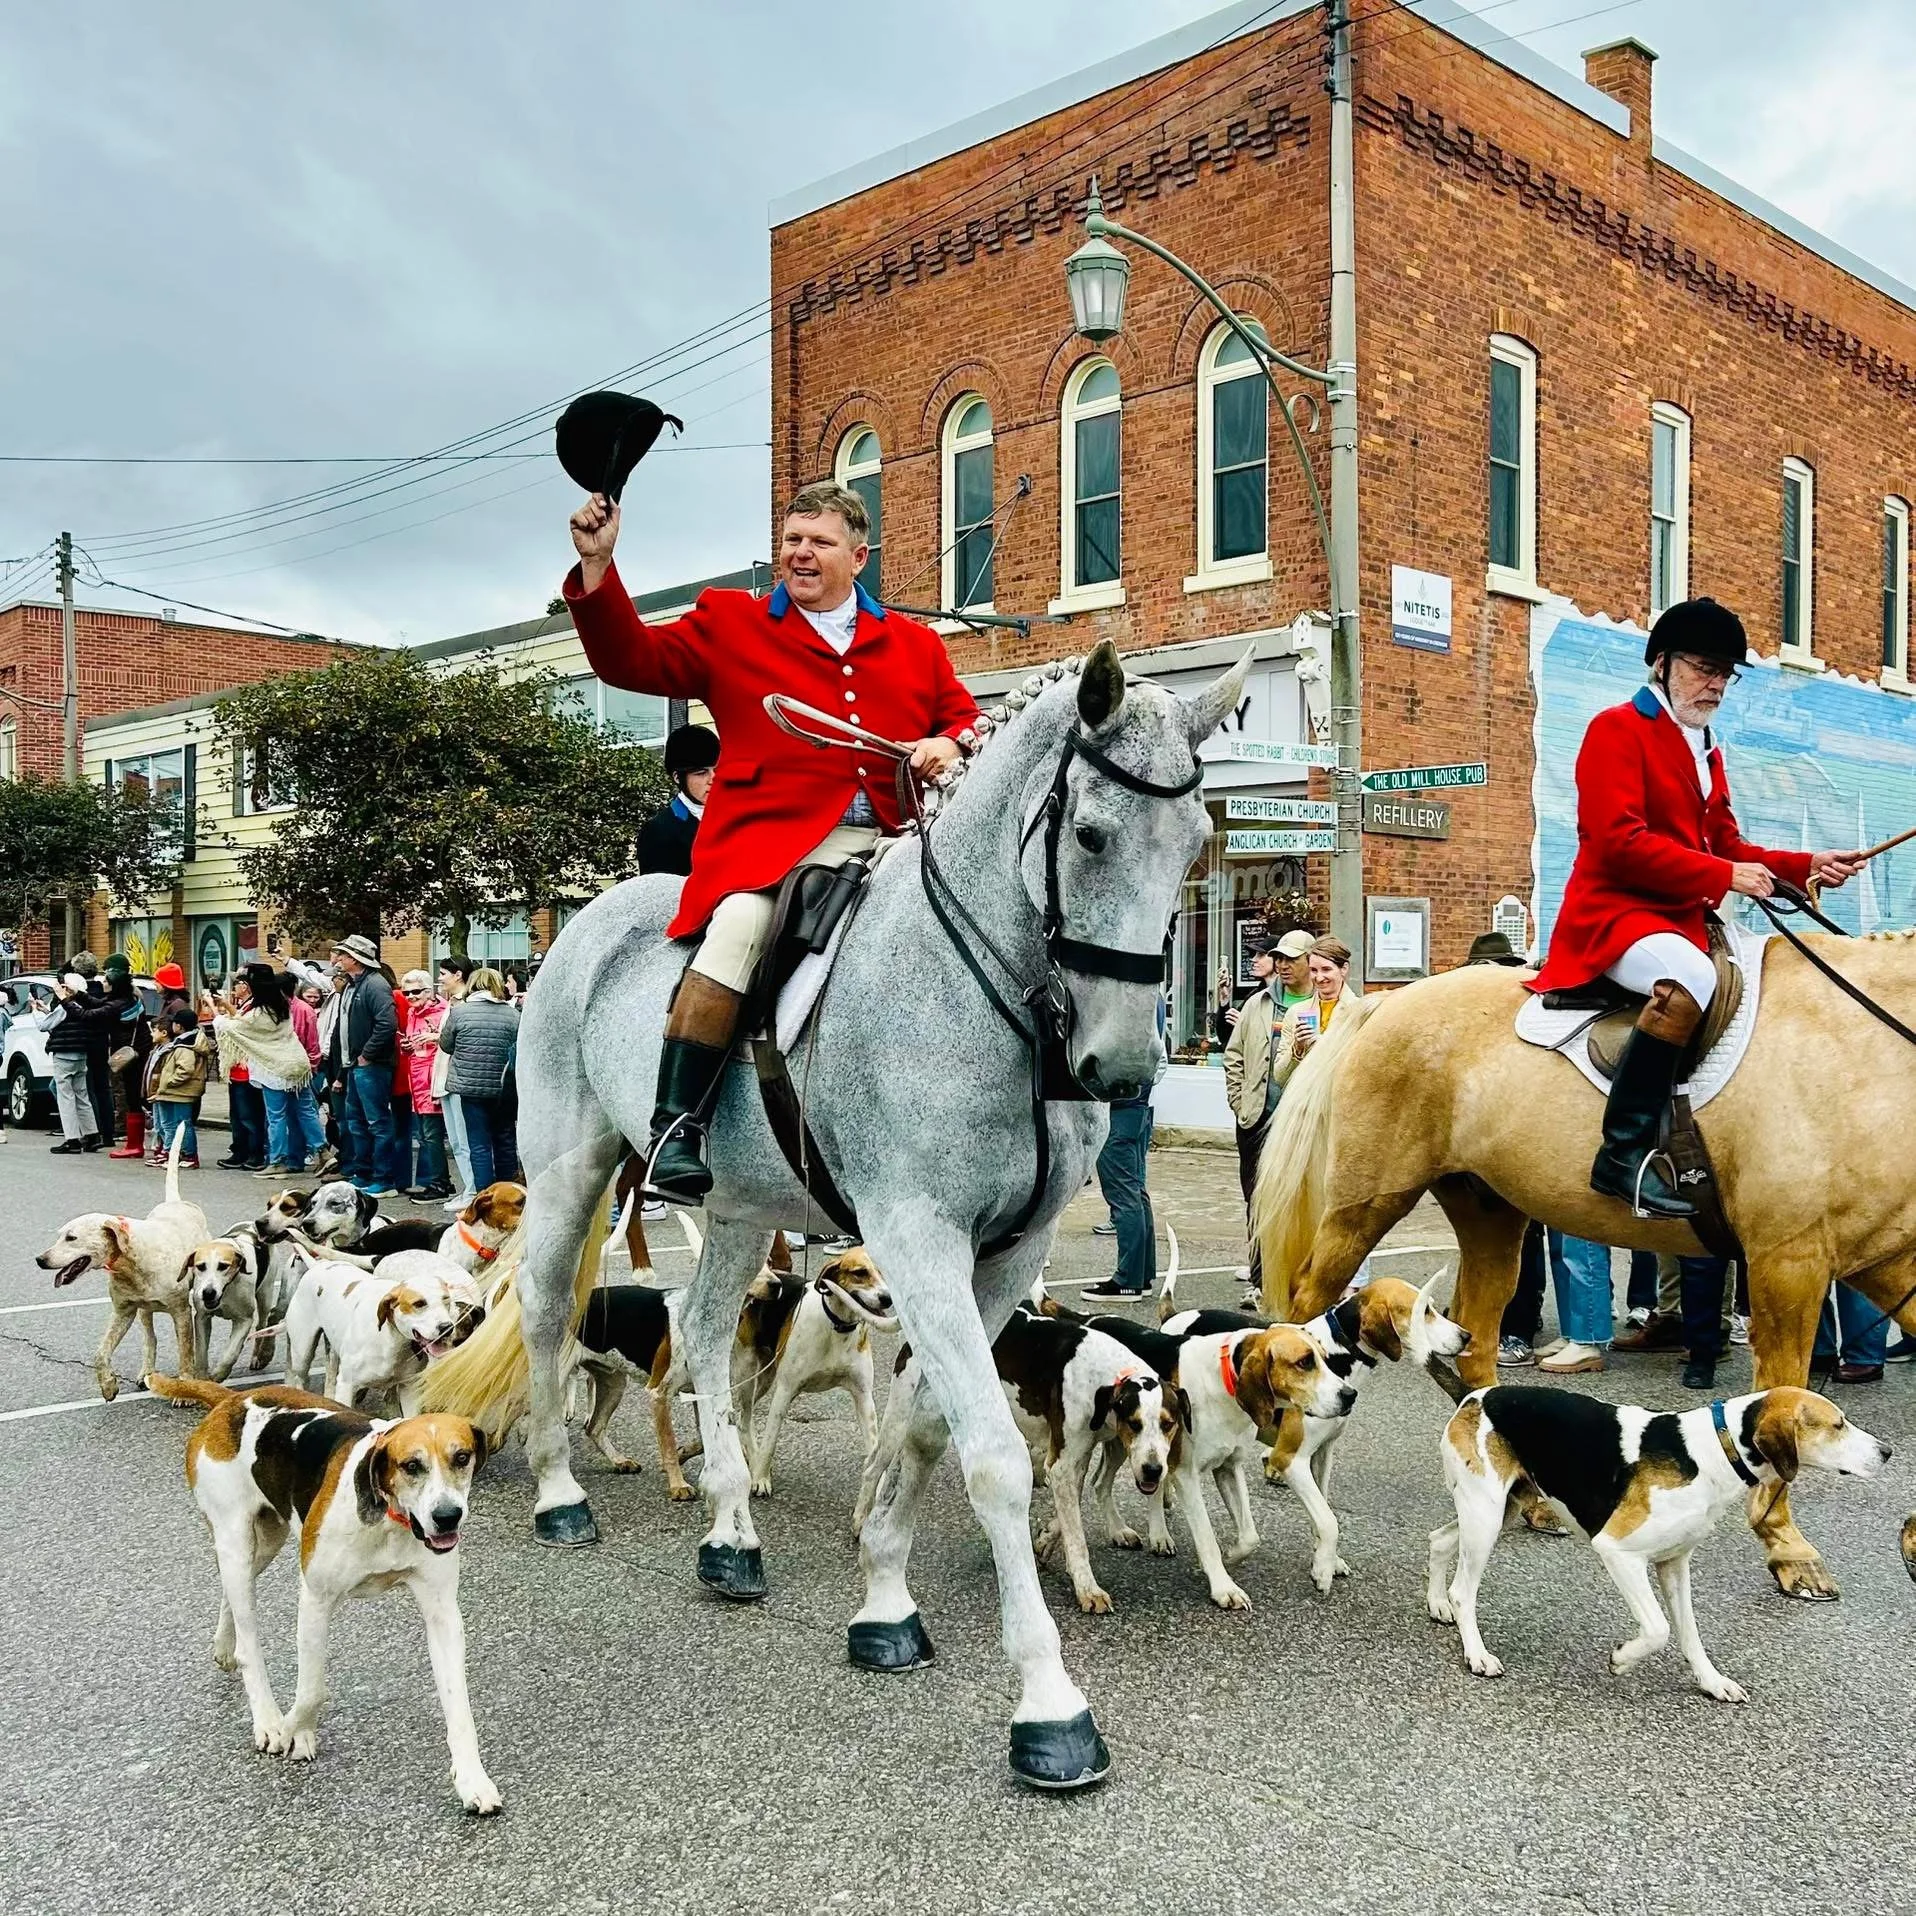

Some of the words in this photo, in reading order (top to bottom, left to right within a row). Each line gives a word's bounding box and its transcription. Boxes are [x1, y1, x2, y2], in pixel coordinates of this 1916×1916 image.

[1403, 599, 1441, 620] NITETIS
[1230, 741, 1240, 757] THE
[1373, 774, 1389, 790] THE
[1391, 772, 1408, 788] OLD
[1411, 770, 1432, 787] MILL
[1434, 768, 1462, 785] HOUSE
[1465, 766, 1484, 783] PUB
[1230, 800, 1293, 817] PRESBYTERIAN
[1297, 804, 1331, 819] CHURCH
[1373, 803, 1444, 829] REFILLERY
[1229, 833, 1266, 849] ANGLICAN
[1268, 833, 1297, 849] CHURCH
[1305, 833, 1332, 849] GARDEN
